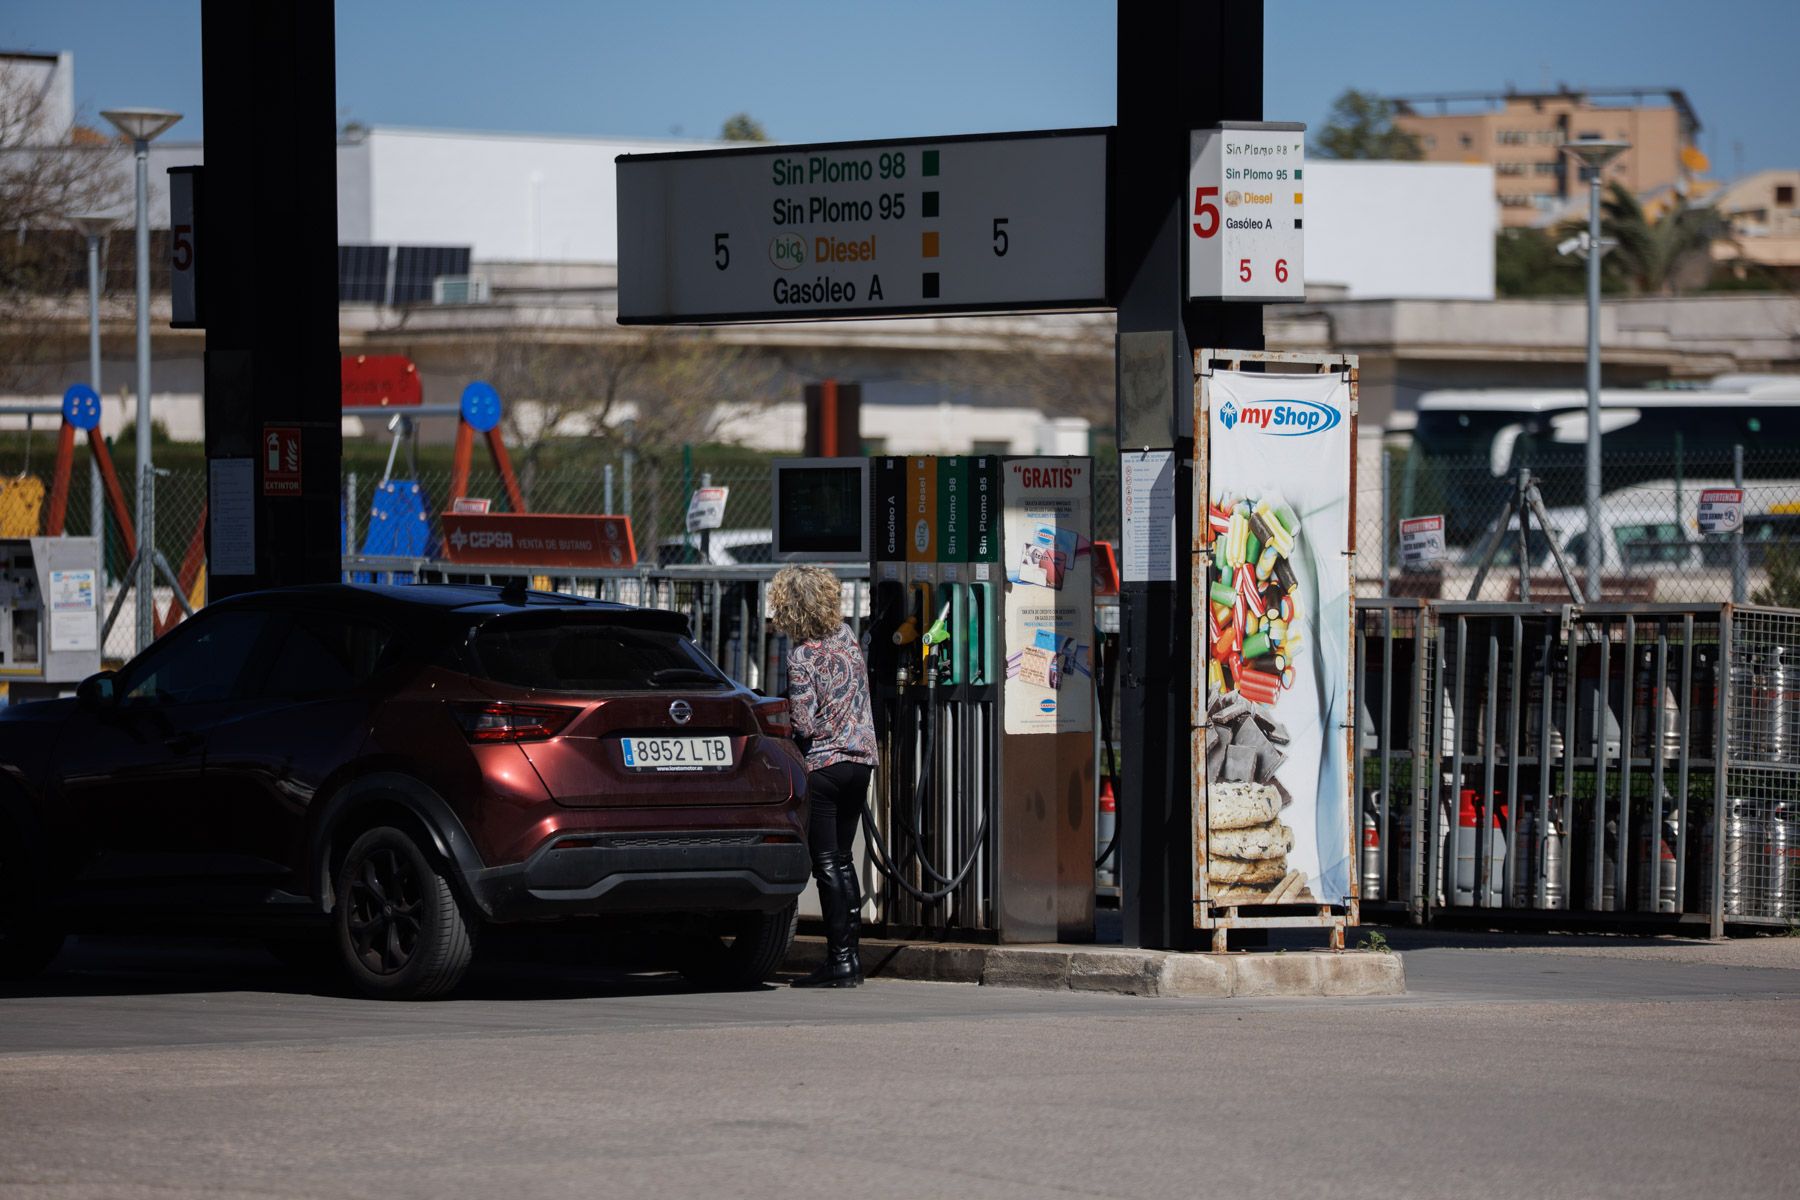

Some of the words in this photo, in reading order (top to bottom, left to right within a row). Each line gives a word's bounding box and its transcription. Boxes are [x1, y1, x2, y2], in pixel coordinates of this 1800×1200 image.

[772, 161, 804, 187] Sin
[809, 156, 873, 184] Plomo
[879, 152, 906, 179] 98
[1226, 168, 1241, 180] Sin
[1243, 168, 1274, 180] Plomo
[1276, 169, 1288, 180] 95
[772, 200, 804, 226] Sin
[809, 196, 873, 223] Plomo
[879, 193, 906, 220] 95
[1244, 192, 1273, 205] Diesel
[1192, 185, 1221, 240] 5
[1225, 217, 1263, 230] Gasóleo
[1265, 218, 1273, 229] A
[173, 224, 192, 271] 5
[814, 234, 877, 263] Diesel
[993, 217, 1009, 257] 5
[714, 232, 730, 271] 5
[1239, 258, 1252, 283] 5
[1275, 258, 1288, 283] 6
[773, 275, 856, 305] Gasóleo
[867, 274, 884, 301] A
[1240, 406, 1320, 430] myShop
[265, 480, 299, 490] EXTINTOR
[918, 477, 926, 513] Diesel
[948, 477, 956, 492] 98
[979, 477, 987, 492] 95
[887, 495, 896, 505] A
[948, 495, 956, 533] Plomo
[979, 494, 987, 532] Plomo
[469, 531, 514, 549] CEPSA
[887, 506, 896, 554] Gasóleo
[517, 538, 544, 550] VENTA
[545, 539, 557, 551] DE
[559, 540, 592, 552] BUTANO
[948, 536, 956, 555] Sin
[979, 535, 987, 555] Sin
[637, 740, 686, 762] 8952
[690, 739, 726, 761] LTB
